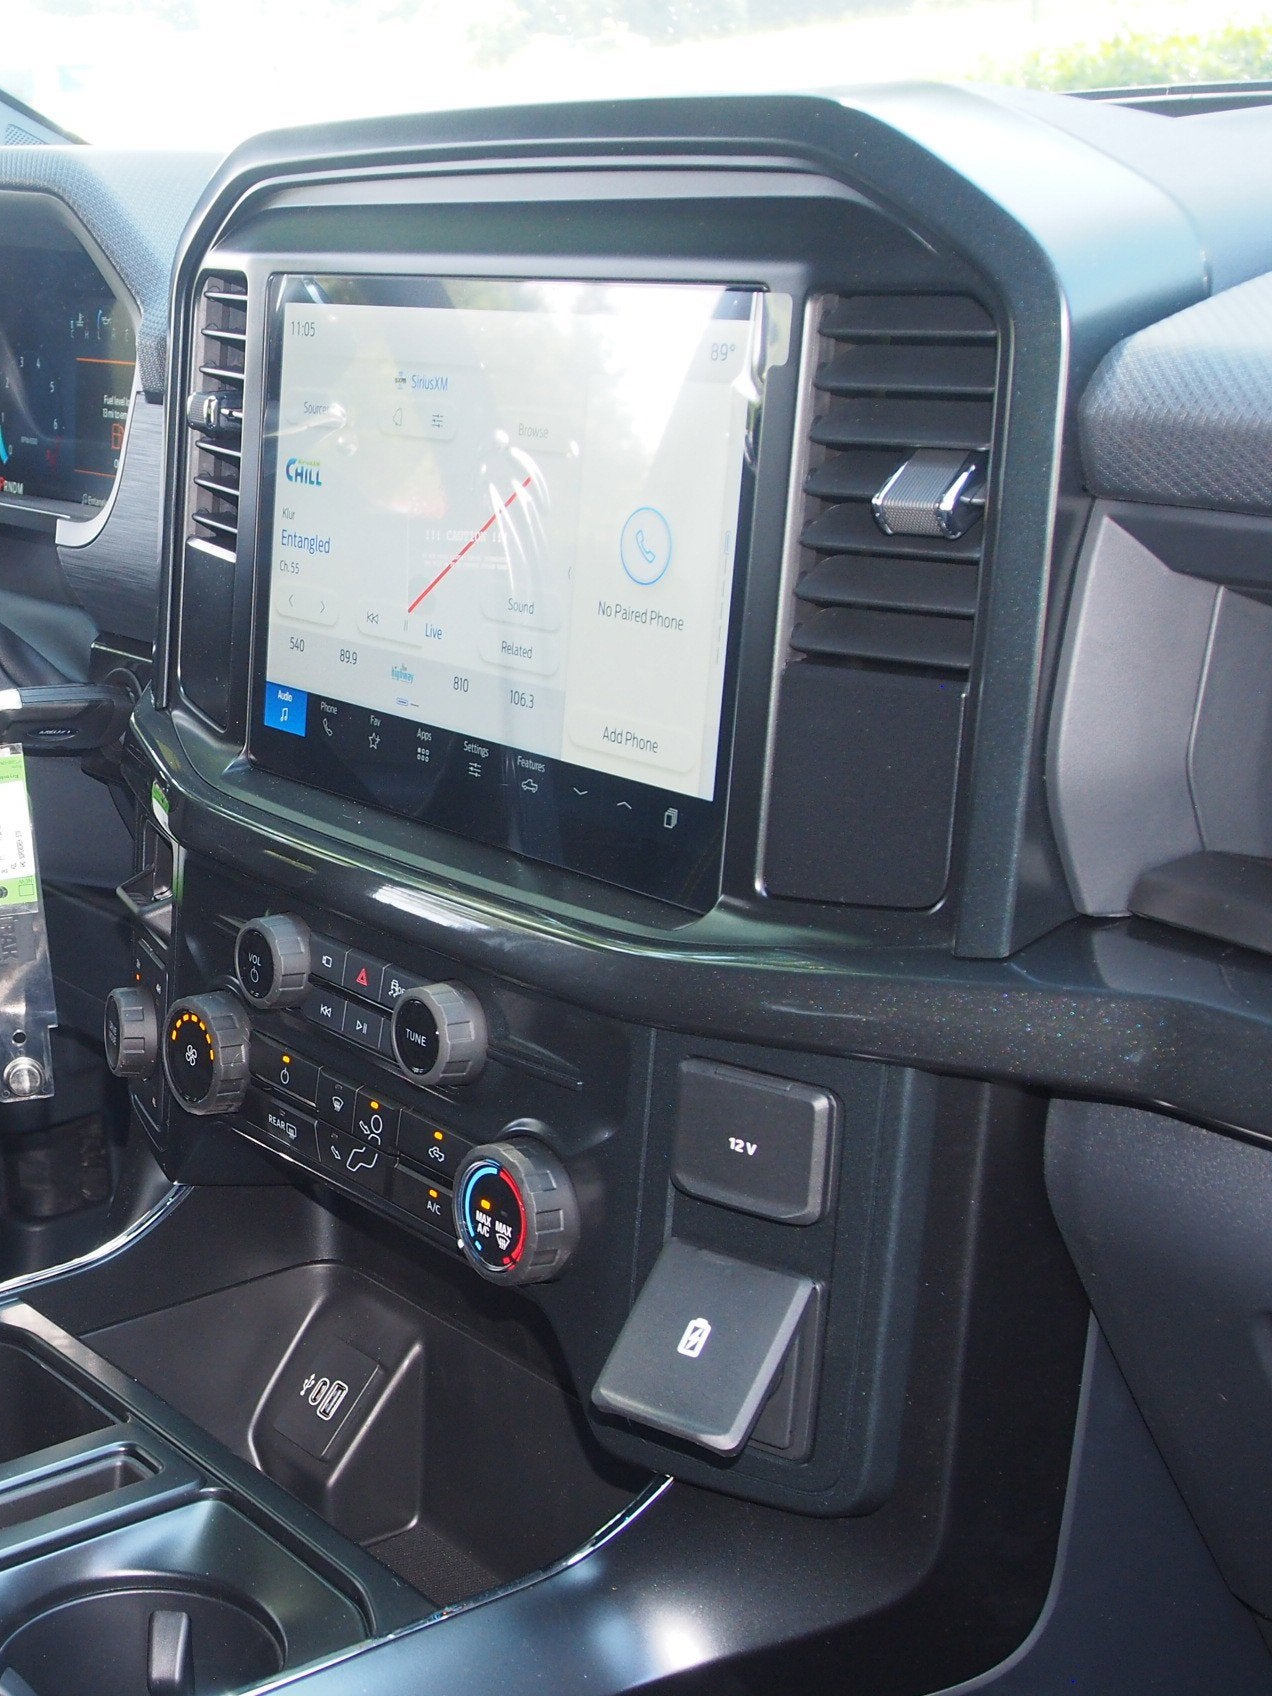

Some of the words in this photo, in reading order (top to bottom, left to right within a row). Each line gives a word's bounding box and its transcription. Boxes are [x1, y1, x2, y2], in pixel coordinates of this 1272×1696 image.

[290, 321, 316, 338] 11:05
[50, 381, 55, 393] 5
[411, 374, 449, 392] SiriusXM
[518, 422, 549, 439] Browse
[285, 457, 323, 486] CHILL
[281, 528, 331, 555] Entangled
[290, 561, 300, 575] 55
[507, 597, 535, 615] Sound
[597, 600, 612, 618] No
[614, 603, 648, 624] Paired
[649, 609, 684, 632] Phone
[425, 622, 443, 640] Live
[289, 636, 305, 653] 540
[501, 640, 533, 660] Related
[339, 648, 359, 665] 89.9
[453, 676, 469, 694] 810
[277, 689, 293, 702] Audio
[509, 689, 535, 710] 106.3
[320, 701, 338, 715] Phone
[370, 714, 382, 727] Fav
[416, 728, 432, 742] Apps
[602, 725, 623, 745] Add
[624, 731, 659, 754] Phone
[463, 740, 490, 759] Settings
[516, 755, 547, 774] Features
[248, 953, 262, 967] VOL
[405, 1027, 428, 1048] TUNE
[268, 1113, 286, 1132] REAR
[427, 1200, 442, 1216] A/C
[475, 1209, 492, 1228] MAX
[476, 1222, 490, 1238] A/C
[495, 1219, 513, 1238] MAX
